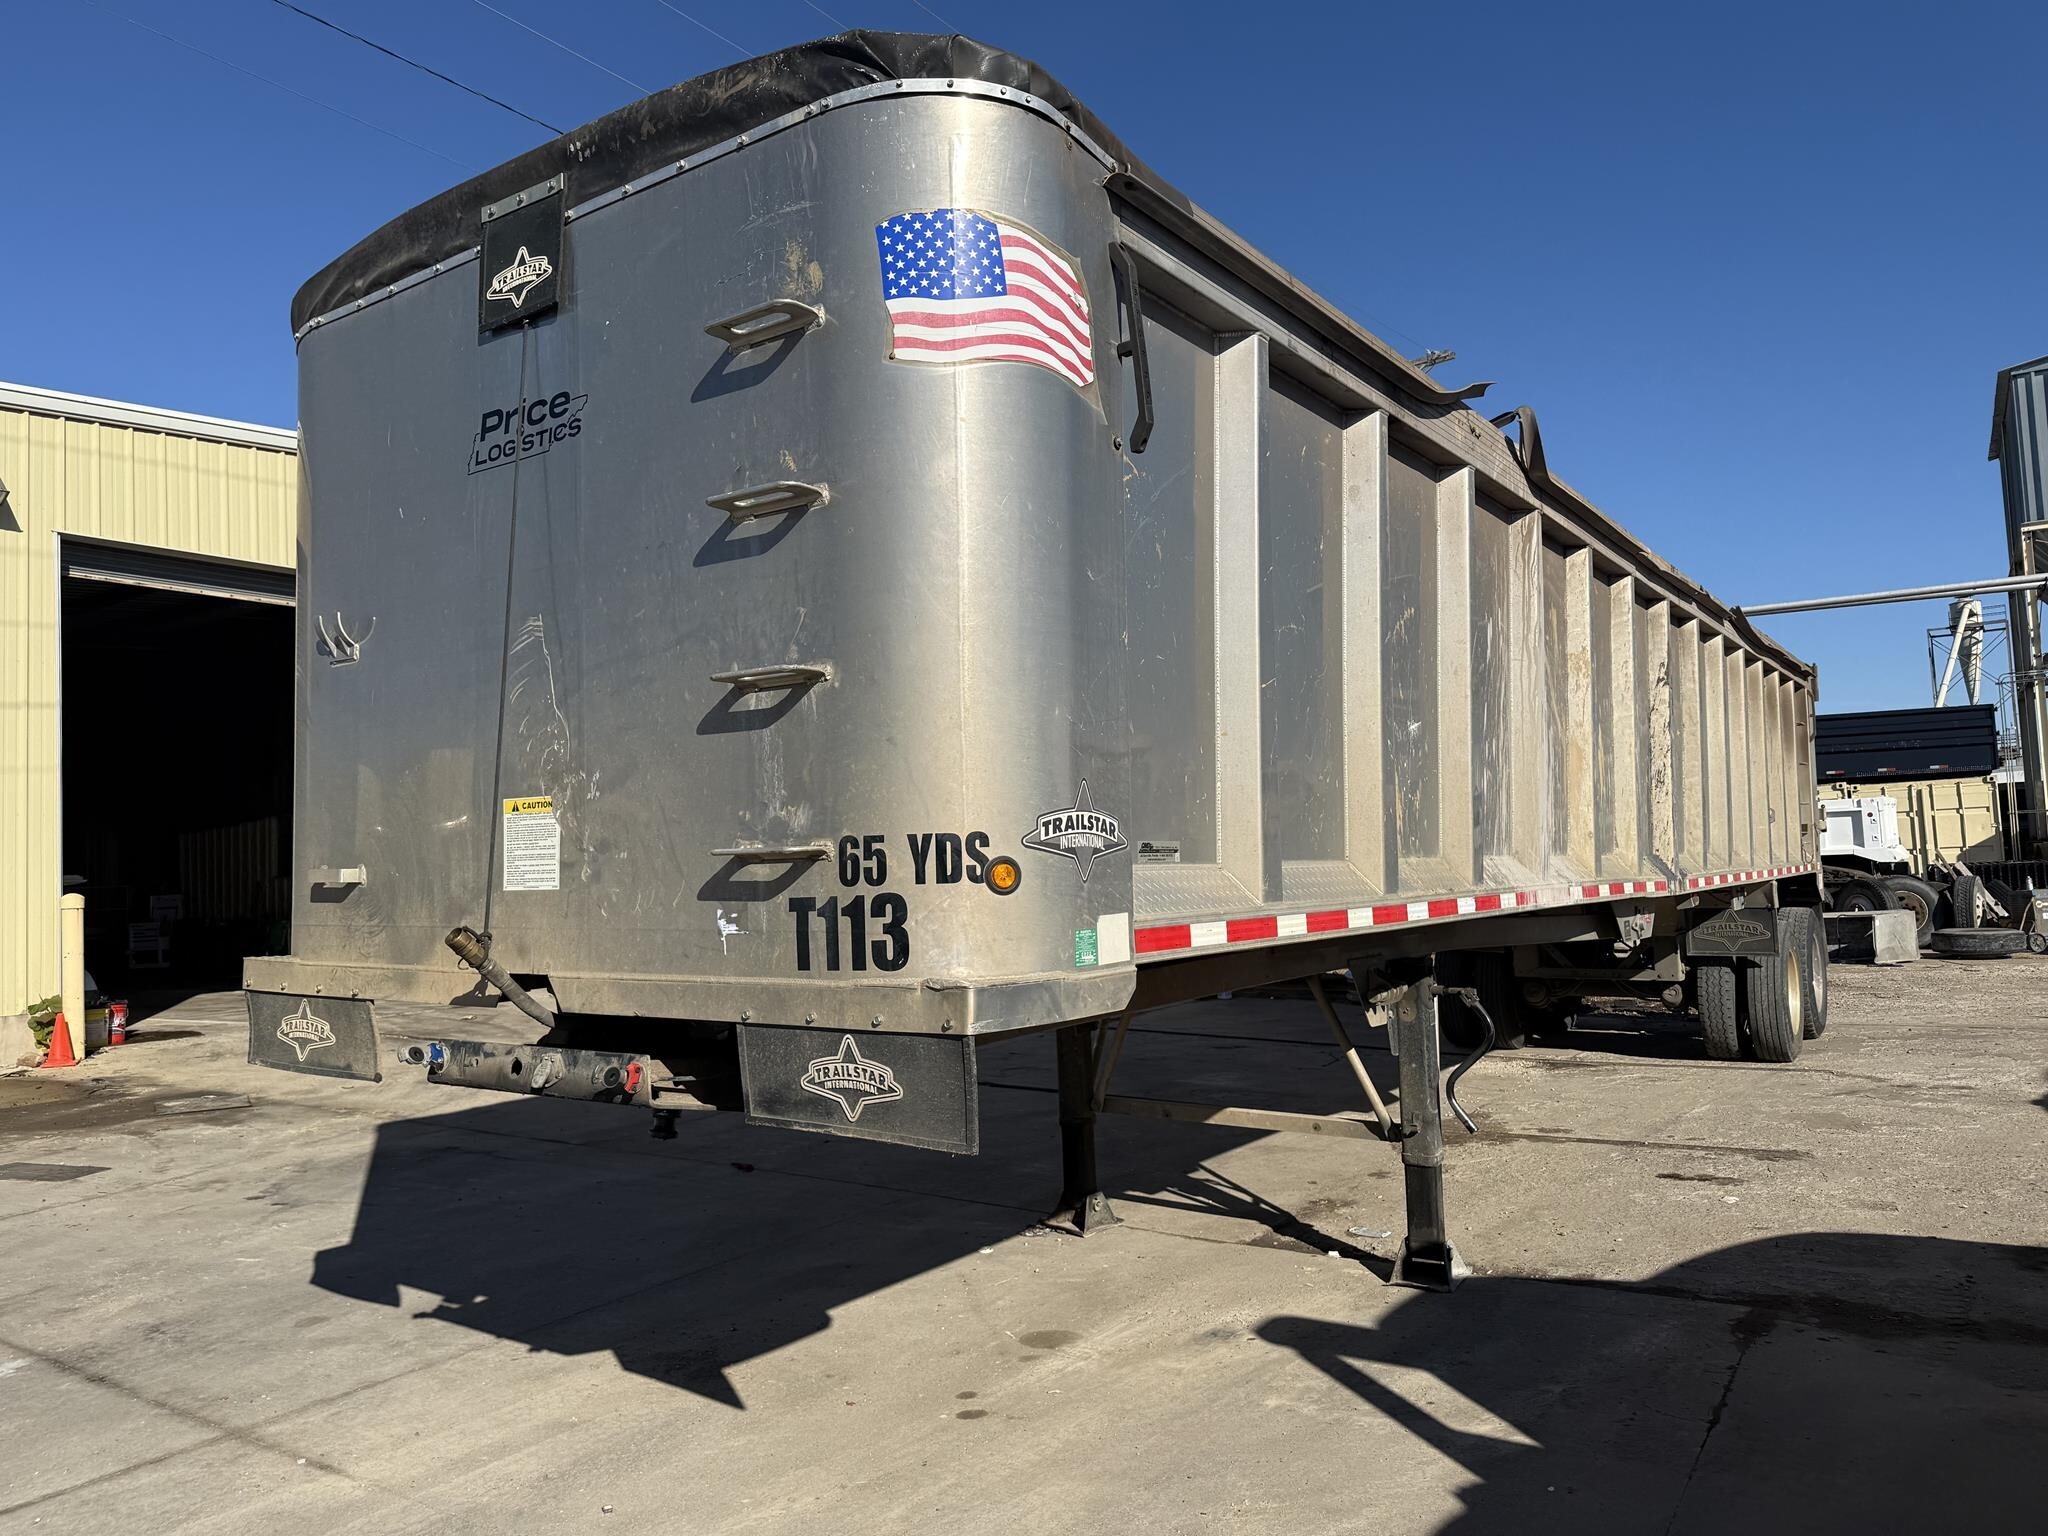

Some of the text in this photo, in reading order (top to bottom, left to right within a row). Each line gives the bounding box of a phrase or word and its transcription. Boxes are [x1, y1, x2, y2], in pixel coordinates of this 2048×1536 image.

[498, 262, 543, 288] TRAILSTAR
[480, 391, 571, 442] Price
[475, 418, 582, 466] LOGSTICS
[522, 800, 553, 810] CAUTION
[1042, 814, 1117, 840] TRAILSTAR
[1060, 833, 1105, 850] INTERNATIONAL
[838, 831, 990, 887] 65 YDS
[788, 892, 910, 972] T113
[1704, 922, 1760, 935] TRAILSTAR
[285, 1019, 327, 1037] TRAILSTAR
[814, 1065, 887, 1088] TRAILSTAR
[824, 1080, 879, 1095] INTERNATIONAL
